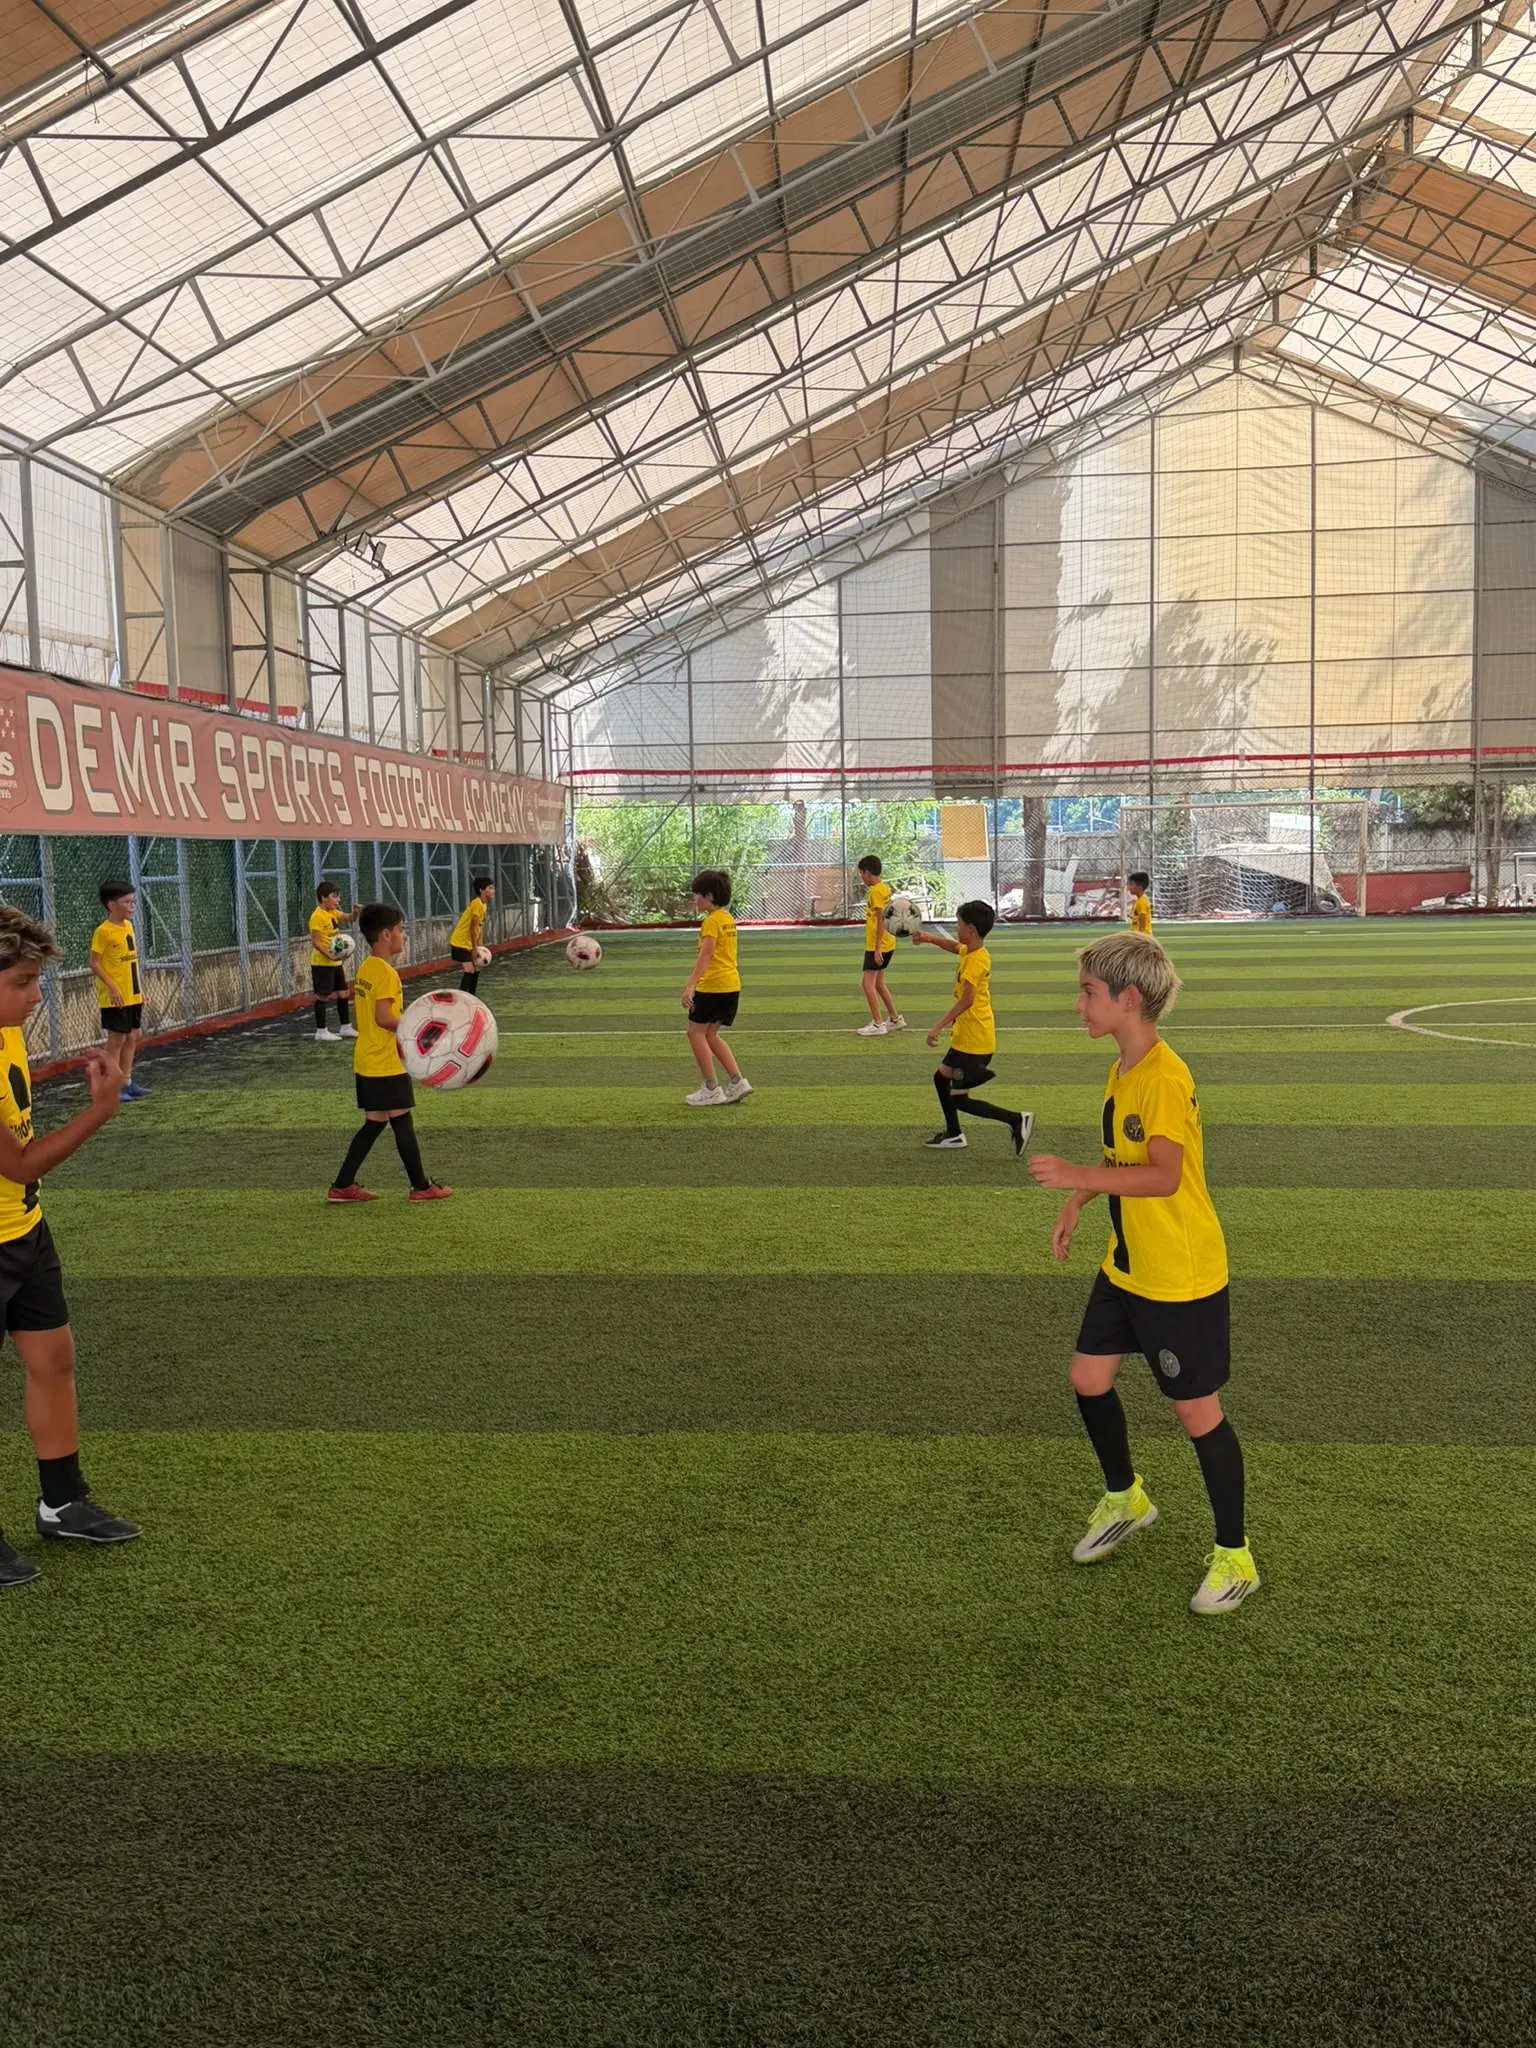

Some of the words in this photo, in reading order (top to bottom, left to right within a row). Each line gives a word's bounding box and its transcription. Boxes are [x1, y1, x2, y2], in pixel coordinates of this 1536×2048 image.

[215, 730, 353, 825] SPORTS
[354, 756, 464, 832] FOOTBALL
[463, 777, 527, 833] ACADEMY
